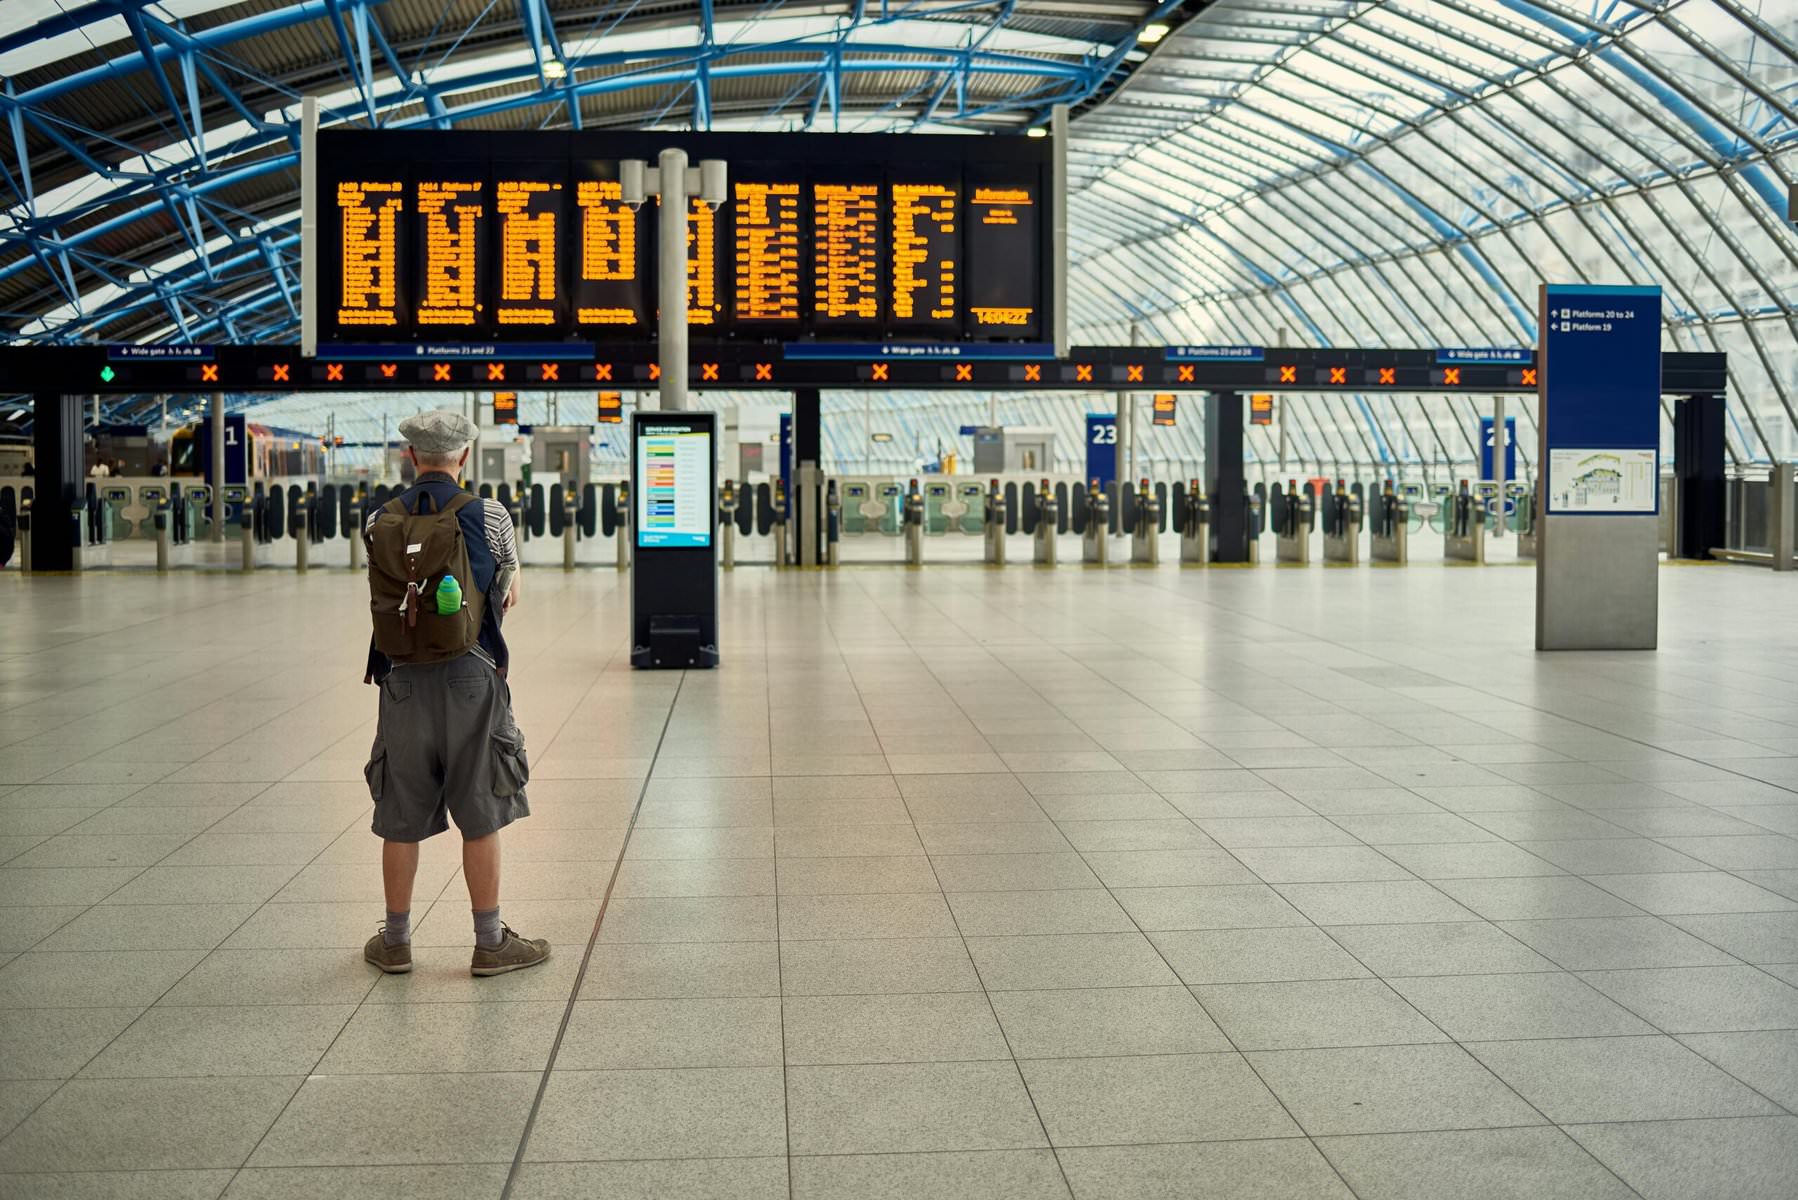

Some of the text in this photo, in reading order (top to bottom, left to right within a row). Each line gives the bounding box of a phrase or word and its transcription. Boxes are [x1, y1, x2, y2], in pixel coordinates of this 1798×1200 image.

[1572, 310, 1635, 319] Platforms 20 to 24
[1572, 323, 1612, 331] Platform 19
[131, 347, 165, 356] Wide gate
[427, 347, 460, 355] Platforms
[1092, 424, 1118, 445] 23
